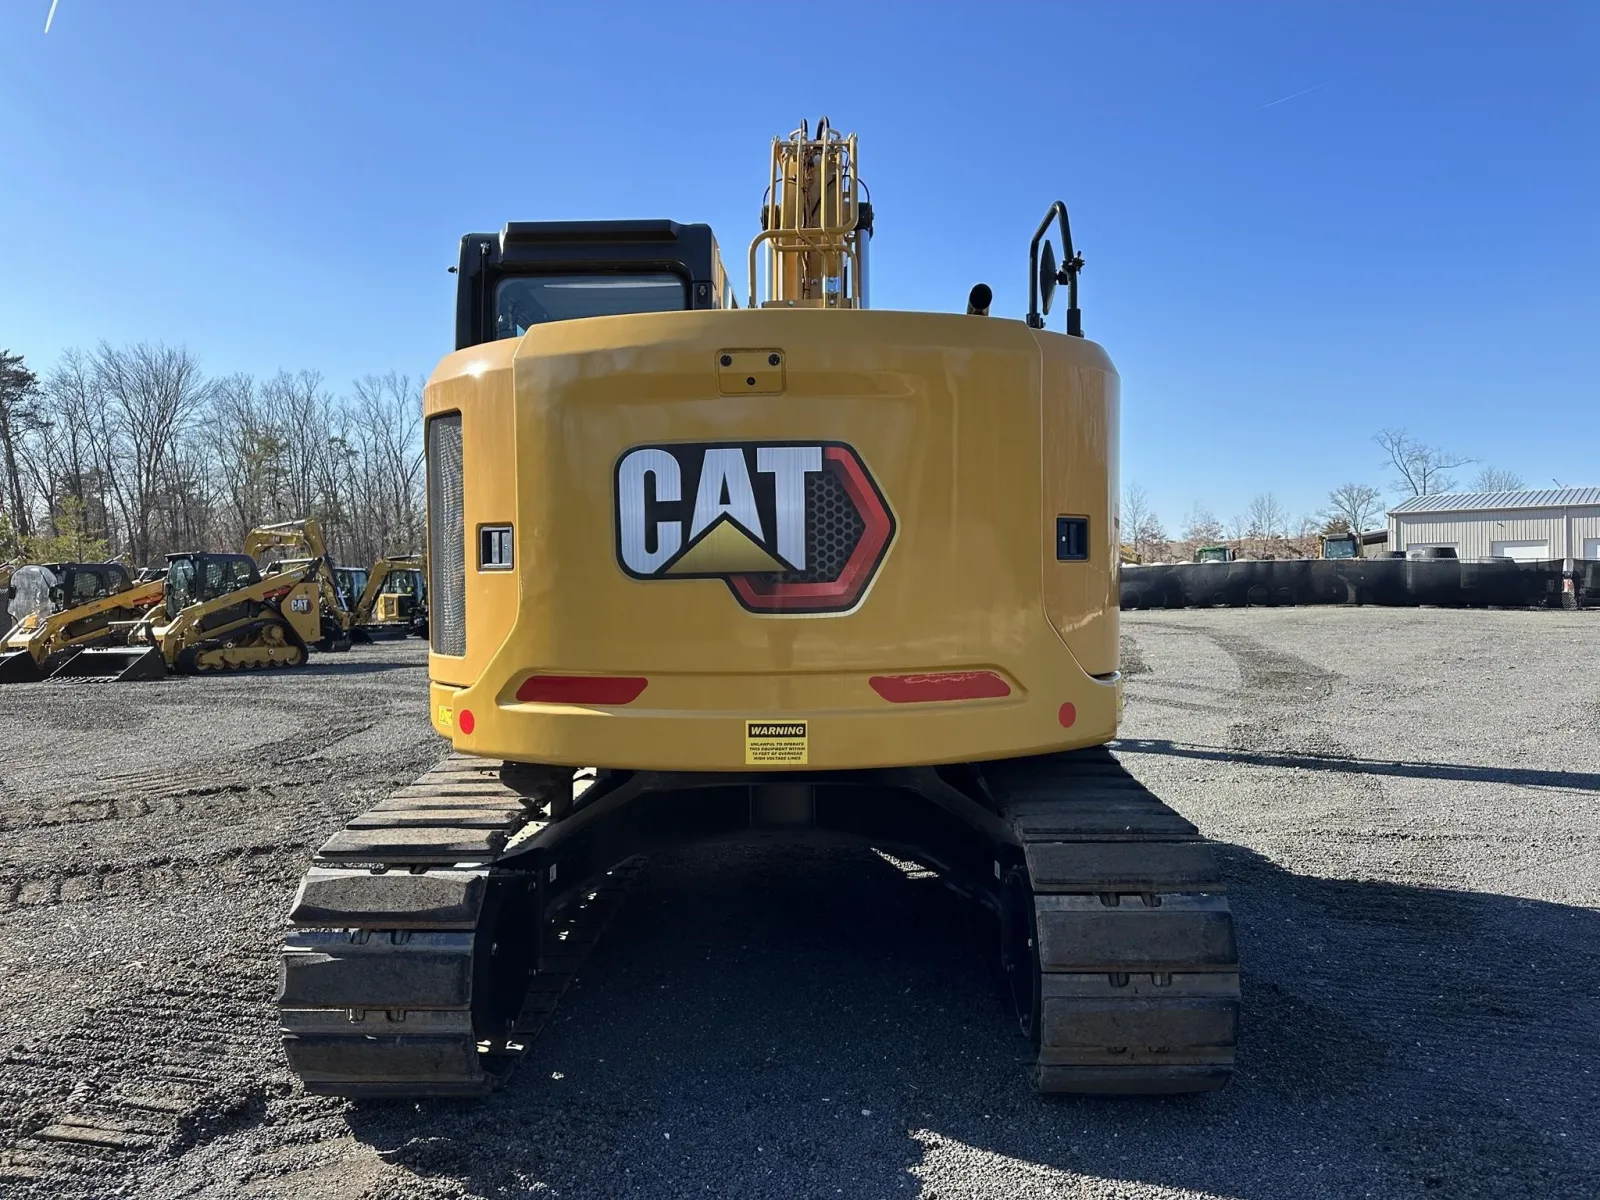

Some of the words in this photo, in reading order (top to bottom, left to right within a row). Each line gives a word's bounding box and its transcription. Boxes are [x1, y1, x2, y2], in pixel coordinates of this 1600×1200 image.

[618, 446, 823, 575] CAT
[291, 599, 308, 612] CAT
[751, 726, 804, 735] WARNING
